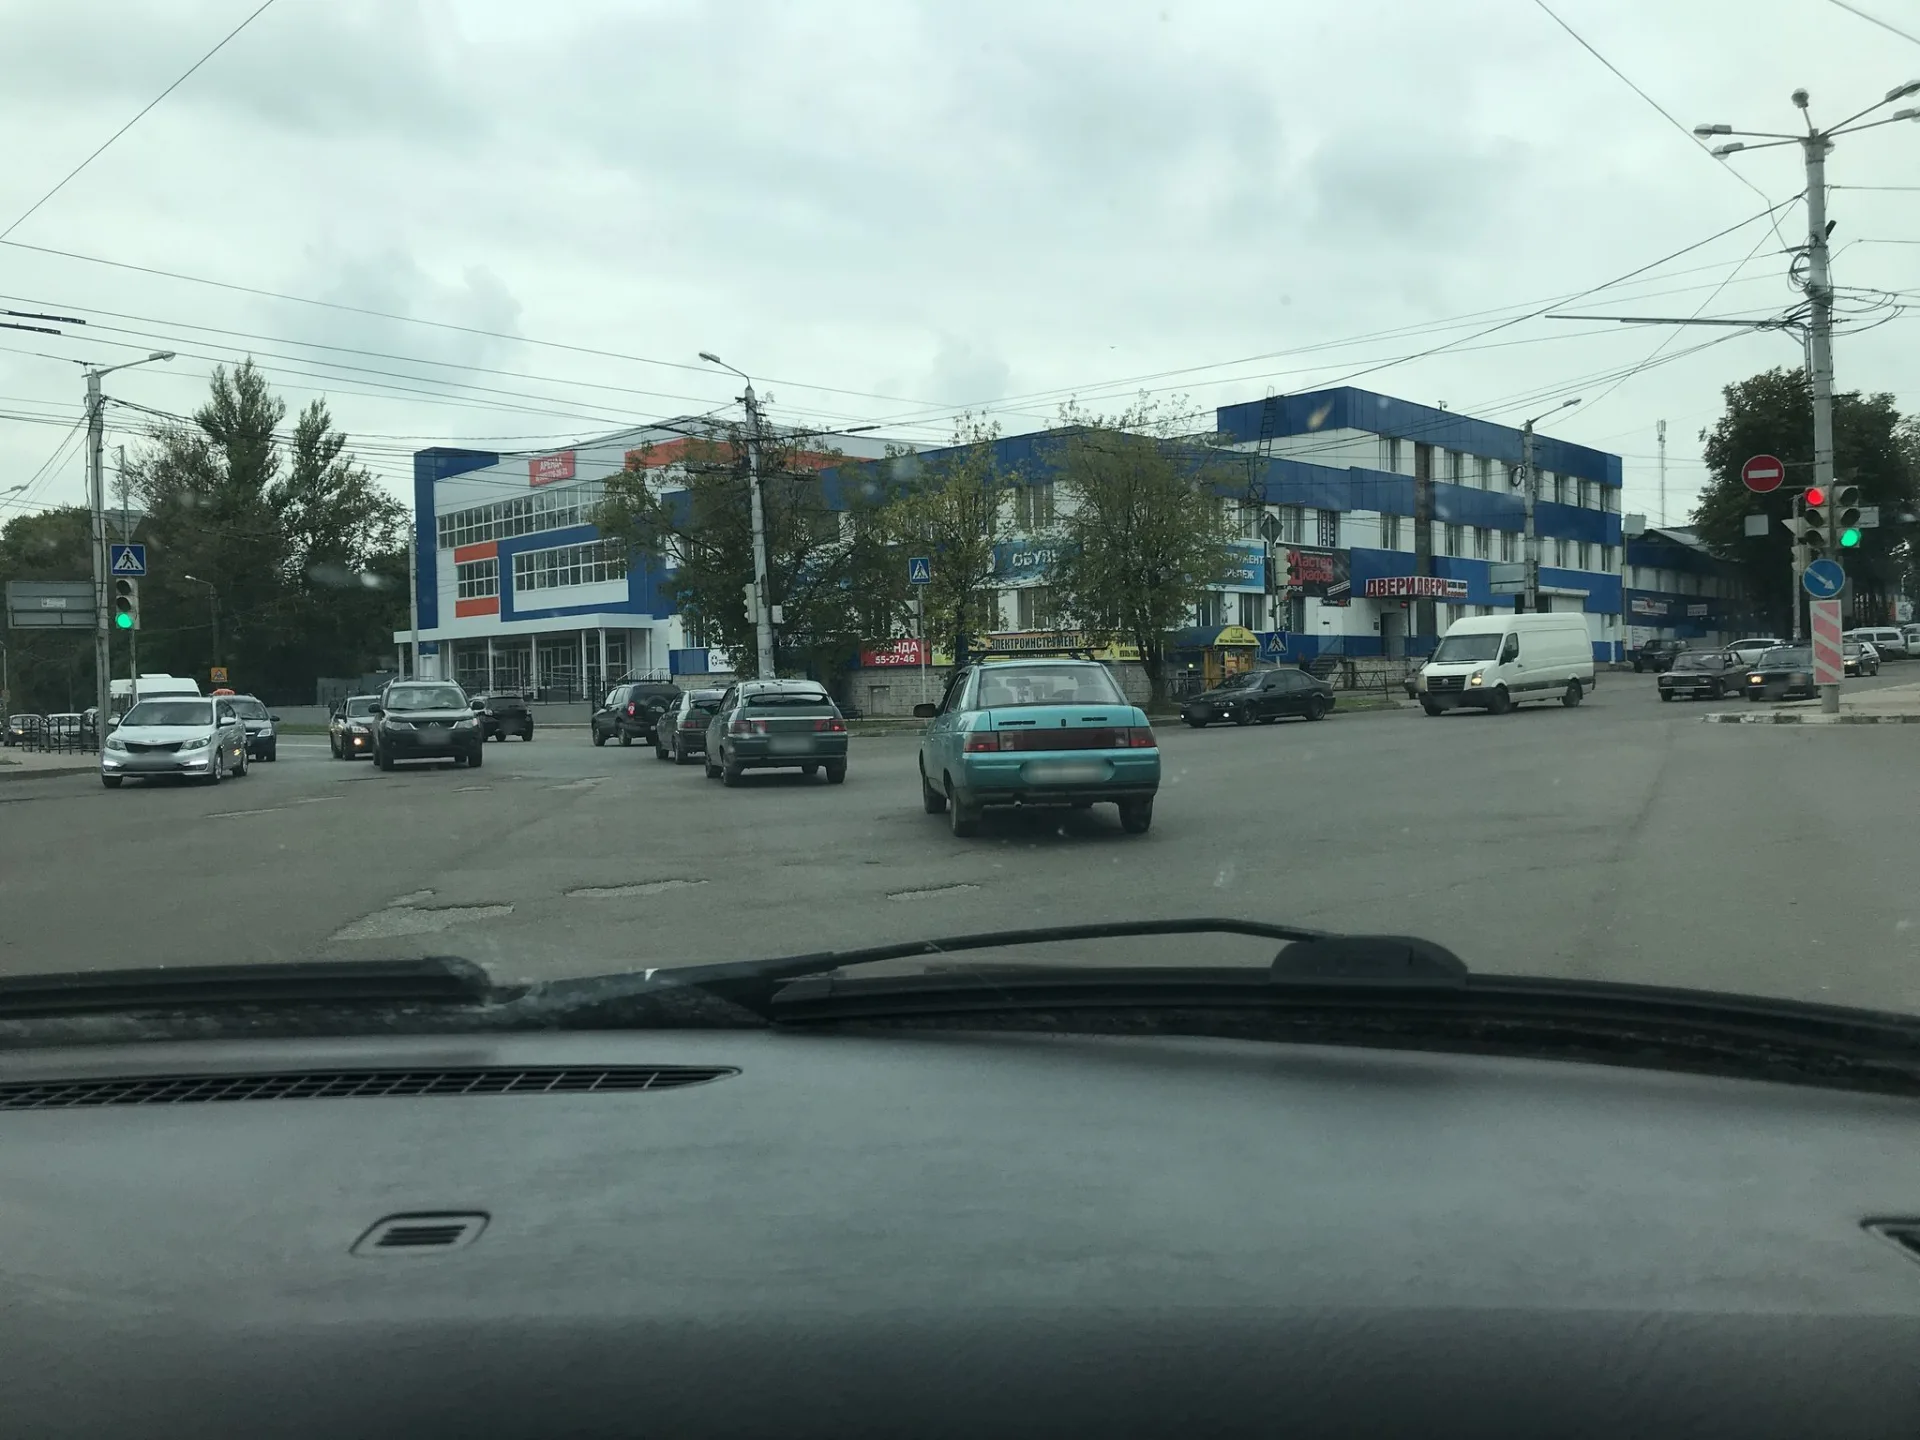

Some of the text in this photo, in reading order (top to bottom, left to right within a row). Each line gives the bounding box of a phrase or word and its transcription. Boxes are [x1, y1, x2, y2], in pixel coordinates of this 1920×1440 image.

[1366, 577, 1415, 597] ДВЕРИ
[1416, 577, 1448, 596] ДВЕРИ
[875, 654, 915, 664] 55-27-46
